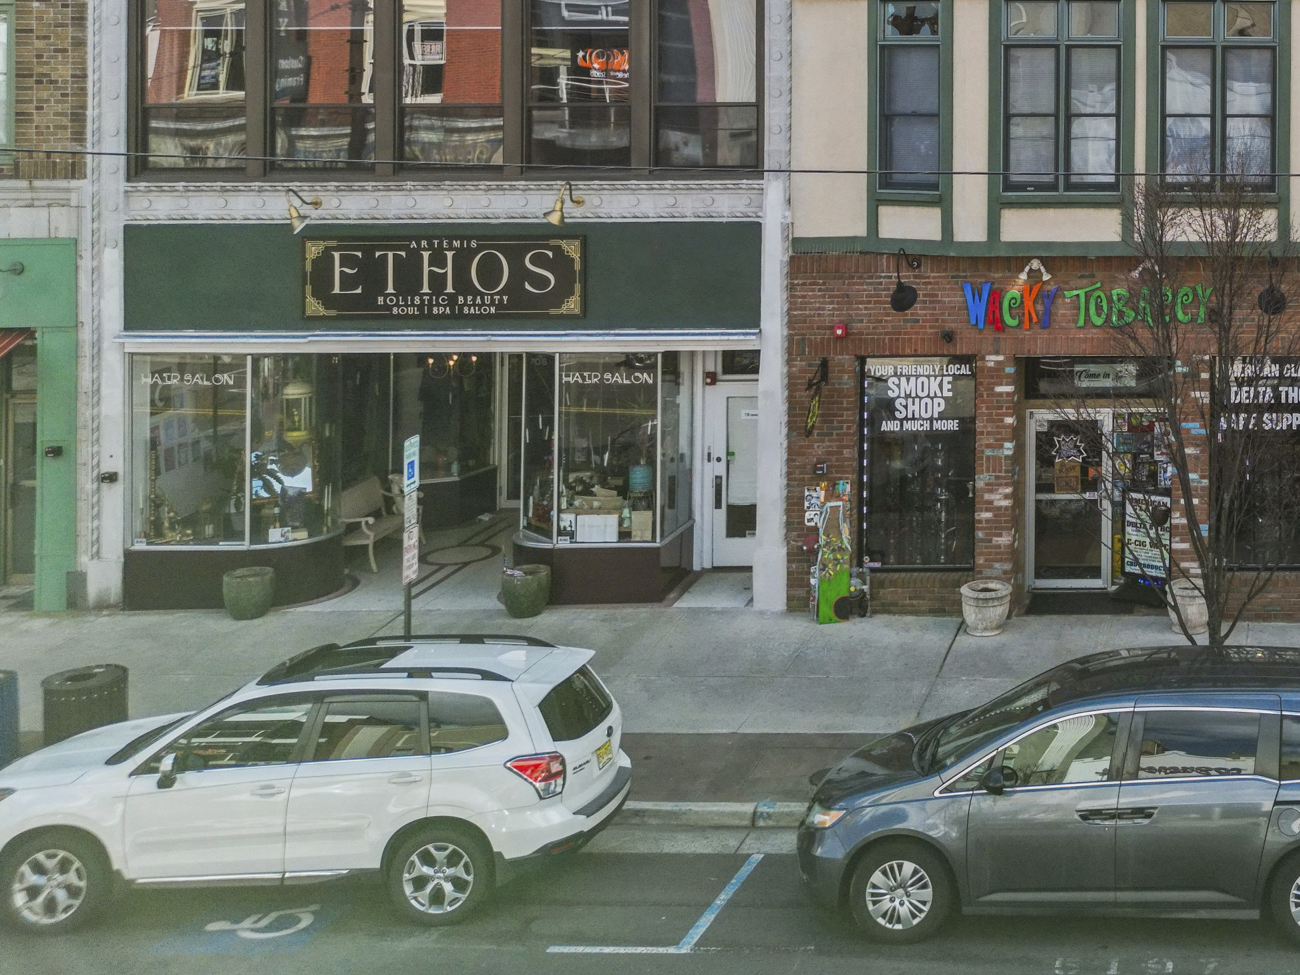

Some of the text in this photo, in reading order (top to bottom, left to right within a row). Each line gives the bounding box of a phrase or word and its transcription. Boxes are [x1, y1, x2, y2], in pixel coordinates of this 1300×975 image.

[410, 239, 478, 249] ARTEMIS
[331, 249, 556, 294] ETHOS
[377, 295, 510, 305] HOLISTIC BEAUTY
[962, 281, 1060, 331] WACKY
[392, 305, 496, 315] SOUL SPA SALON
[869, 364, 971, 376] YOUR FRIENDLY LOCAL
[1075, 369, 1101, 382] Come
[1102, 371, 1111, 379] in
[1222, 363, 1279, 377] MERICAN
[141, 373, 234, 385] HAIR SALON
[562, 372, 654, 384] HAIR SALON
[887, 376, 953, 398] SMOKE
[1230, 386, 1275, 404] DELTA
[894, 397, 946, 419] SHOP
[881, 420, 959, 432] AND MUCH MORE
